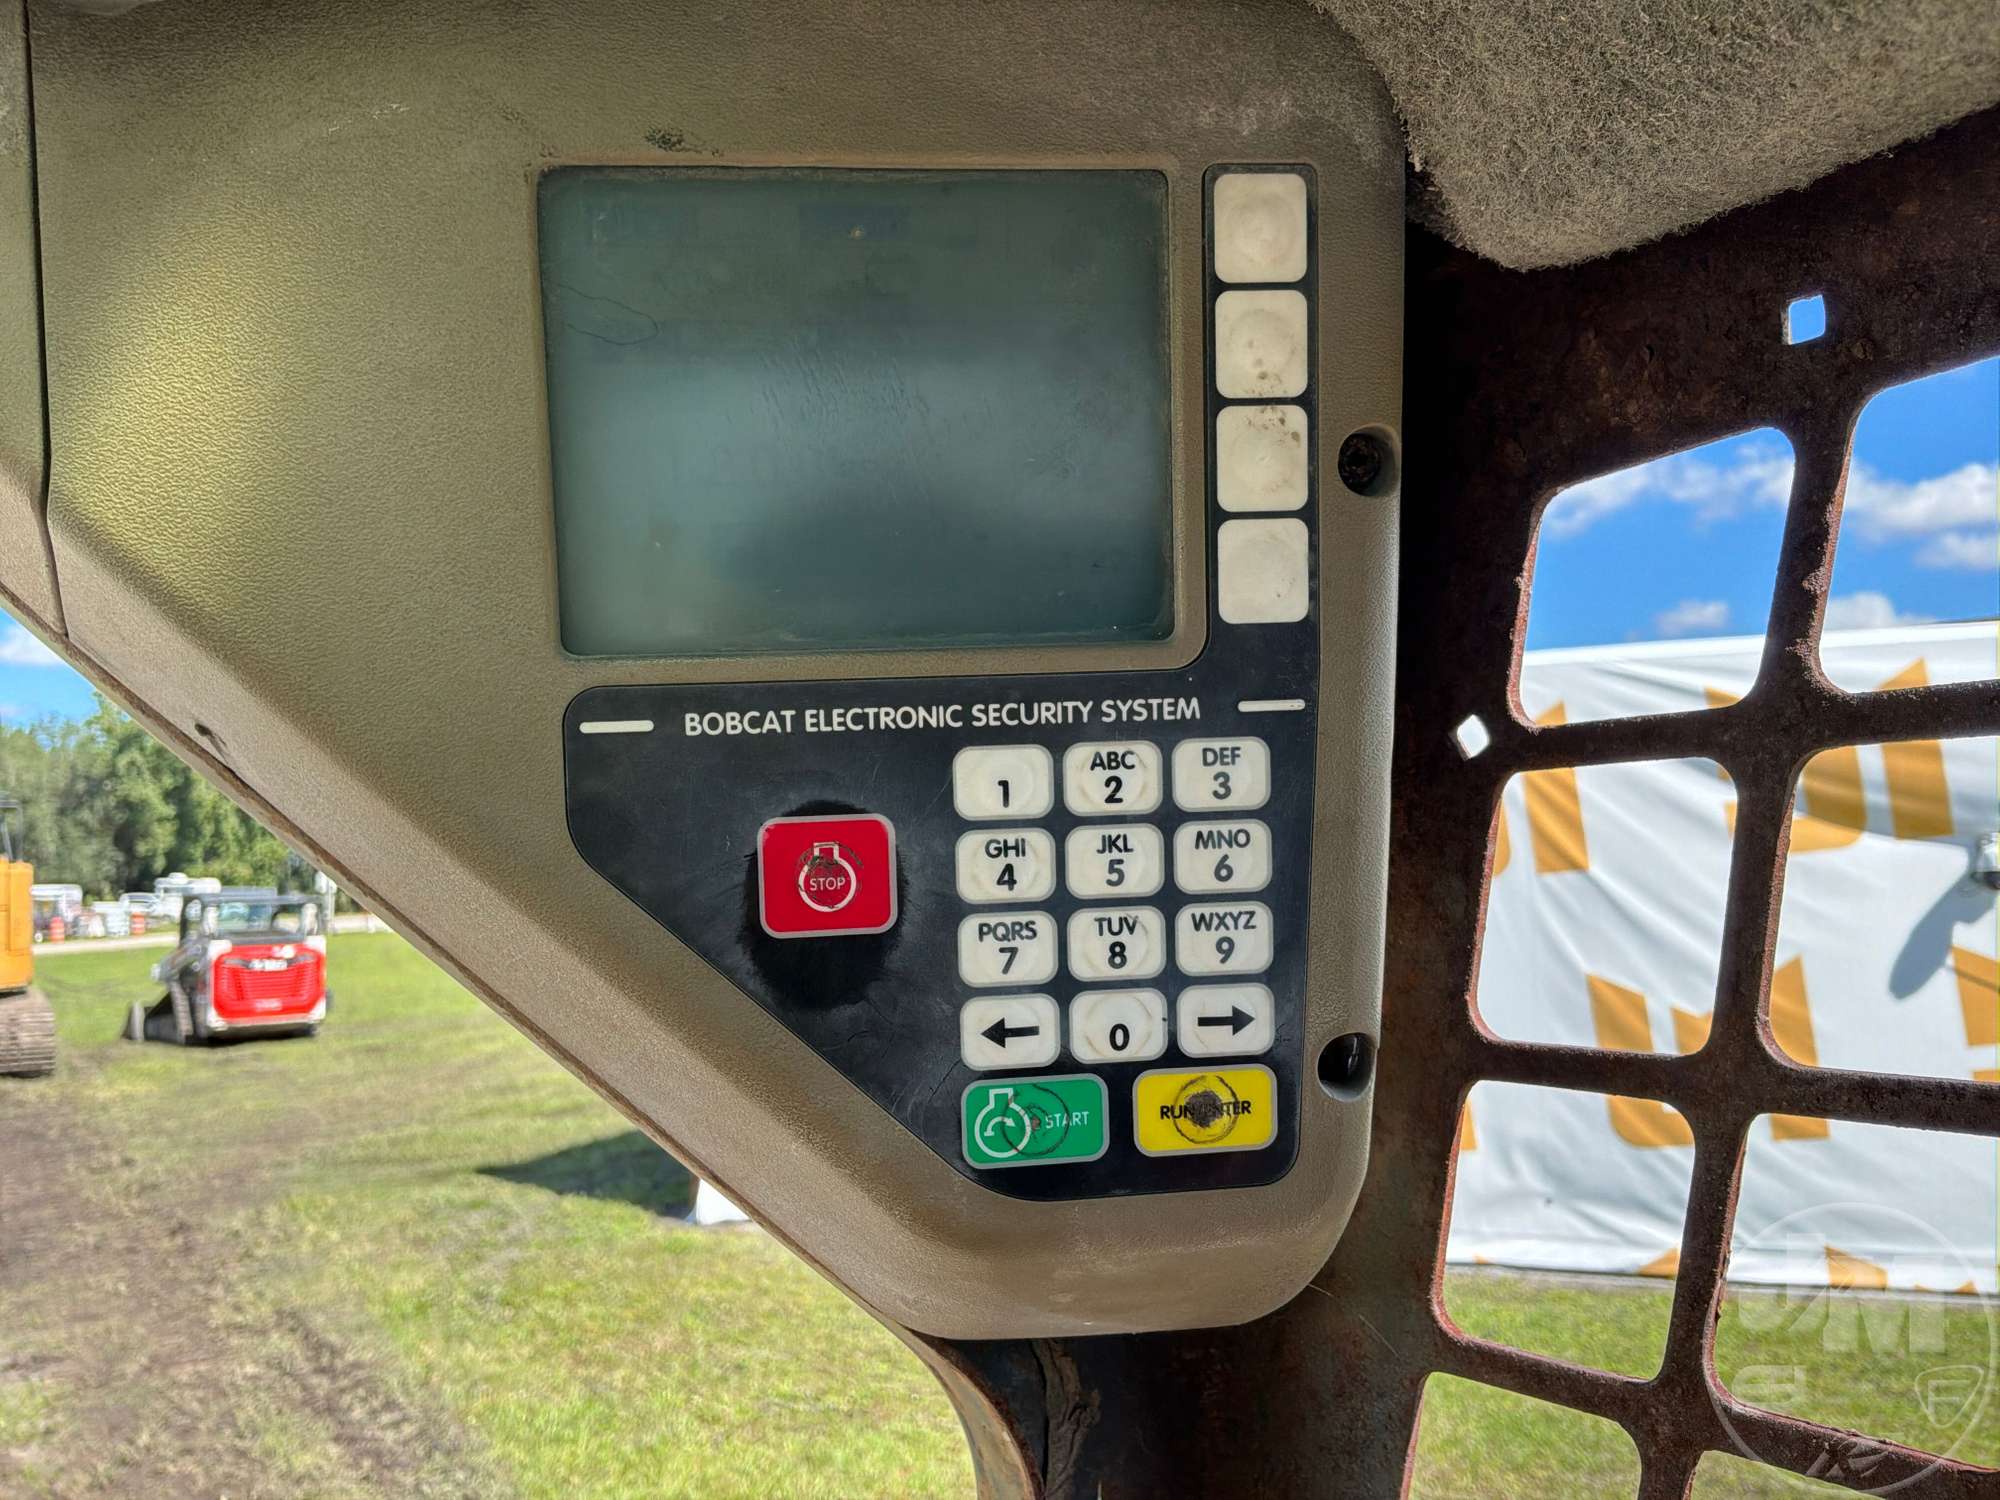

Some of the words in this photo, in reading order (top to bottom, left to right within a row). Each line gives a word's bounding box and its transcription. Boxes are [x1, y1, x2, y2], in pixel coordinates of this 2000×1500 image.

[684, 709, 797, 737] BOBCAT
[804, 704, 963, 733] ELECTRONIC
[971, 700, 1094, 727] SECURITY
[1100, 696, 1201, 723] SYSTEM
[1089, 750, 1136, 772] ABC
[1201, 746, 1242, 767] DEF
[997, 779, 1010, 808] 1
[1104, 775, 1124, 804] 2
[1212, 771, 1232, 801] 3
[984, 837, 1026, 859] GHI
[1096, 833, 1134, 855] JKL
[1194, 828, 1251, 850] MNO
[996, 863, 1018, 892] 4
[1105, 858, 1125, 887] 5
[1213, 853, 1234, 883] 6
[809, 876, 846, 892] STOP
[977, 920, 1038, 943] PQRS
[1093, 915, 1138, 937] TUV
[1190, 910, 1257, 932] WXYZ
[998, 946, 1019, 975] 7
[1107, 940, 1128, 970] 8
[1215, 935, 1236, 965] 9
[1109, 1023, 1130, 1052] 0
[1044, 1110, 1090, 1129] START
